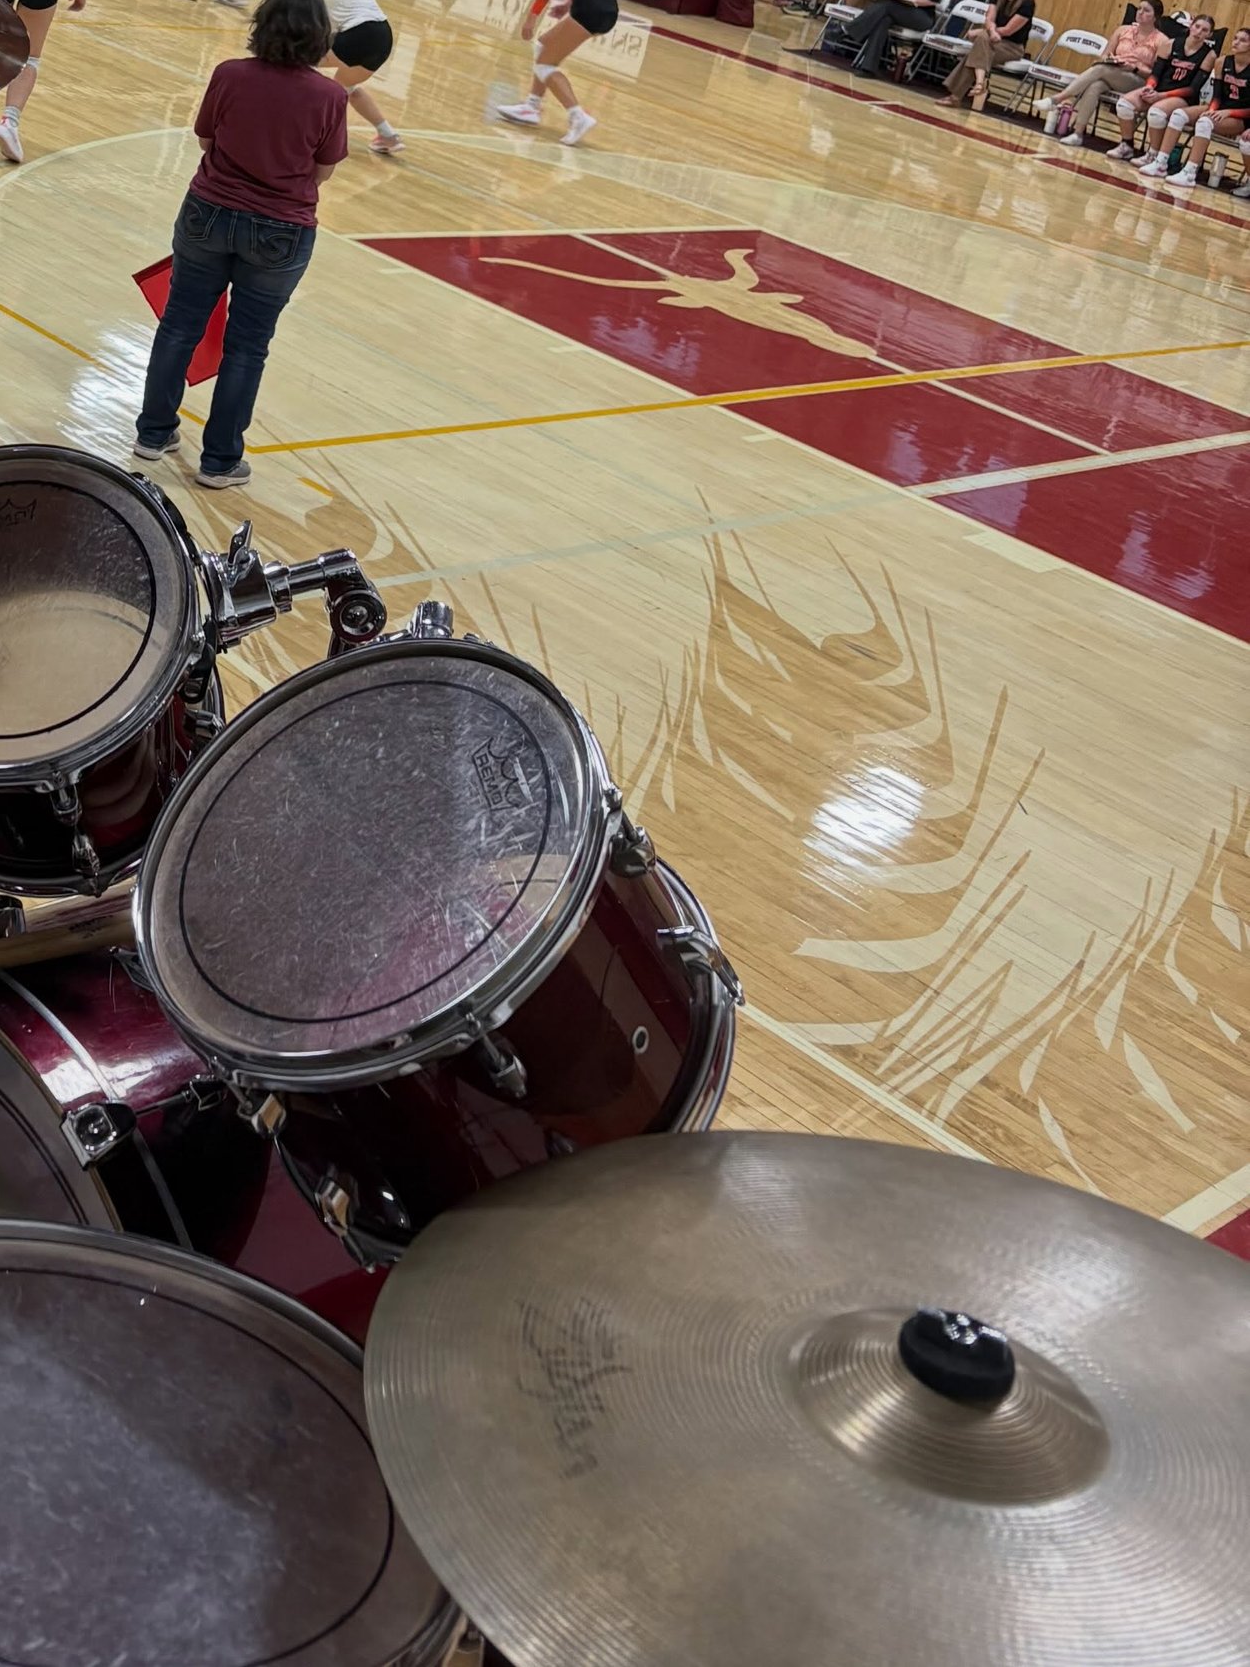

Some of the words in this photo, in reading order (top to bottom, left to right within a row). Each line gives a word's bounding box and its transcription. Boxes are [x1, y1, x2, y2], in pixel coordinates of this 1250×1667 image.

[1065, 35, 1081, 45] FORT
[1081, 38, 1102, 51] BENTON
[476, 753, 503, 805] REMO
